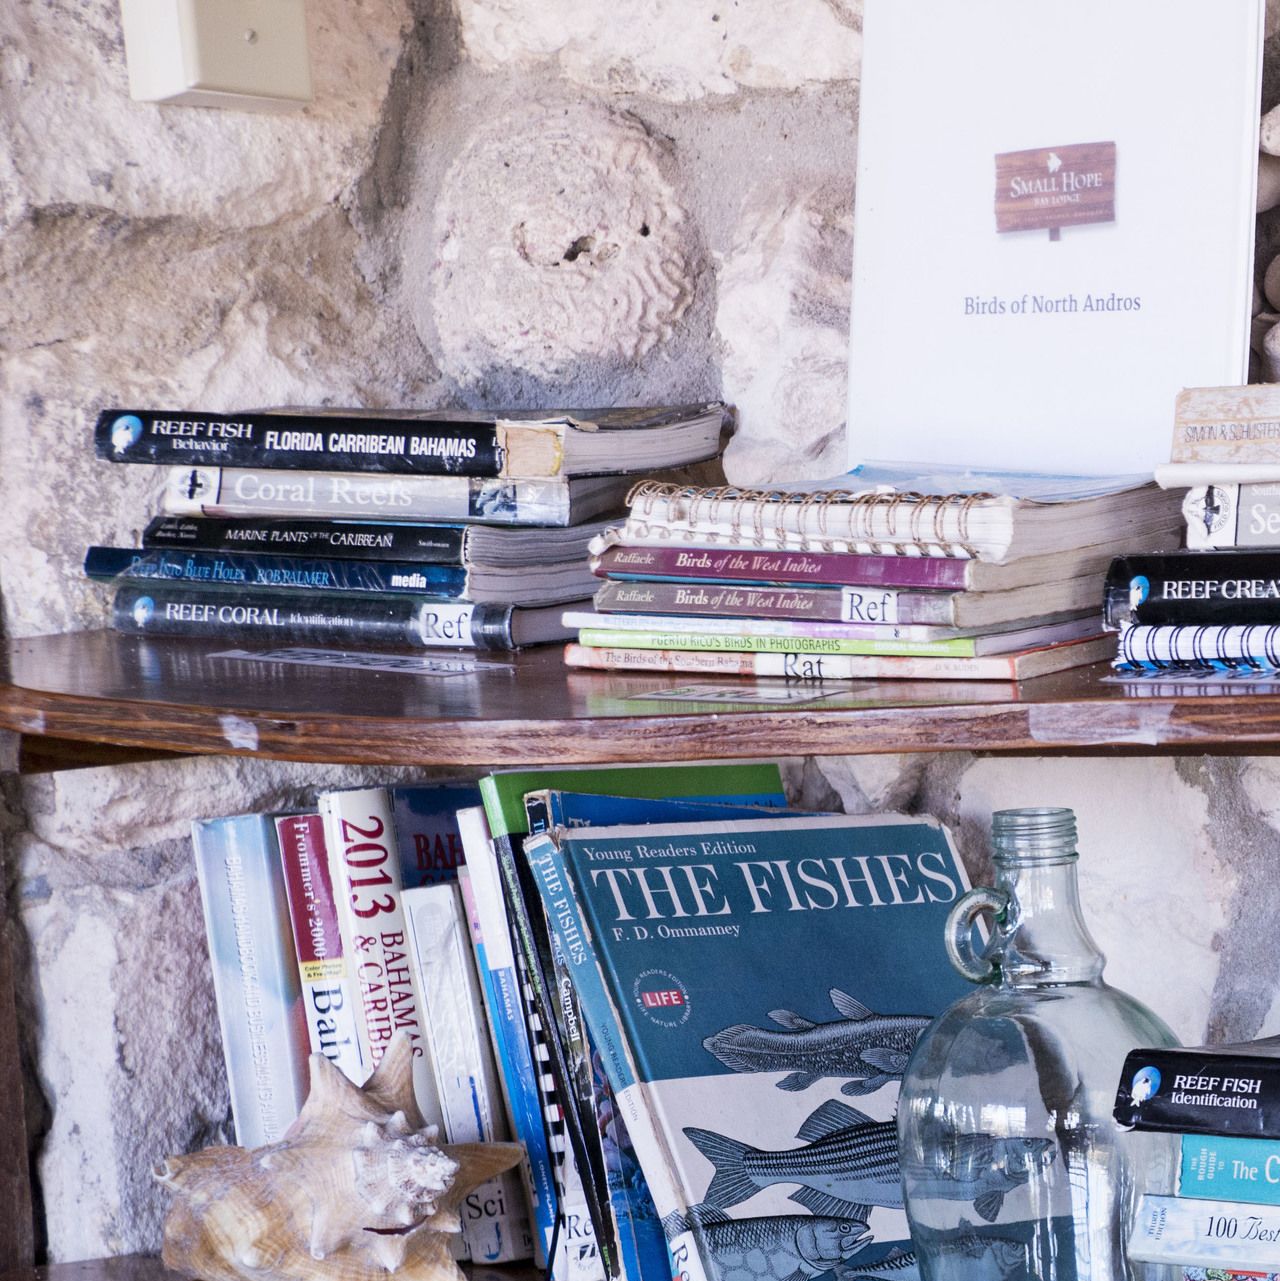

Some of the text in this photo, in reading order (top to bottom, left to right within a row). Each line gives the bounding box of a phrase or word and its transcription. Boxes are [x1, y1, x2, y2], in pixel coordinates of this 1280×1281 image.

[1010, 172, 1102, 198] SMALL HOPE
[964, 292, 1141, 316] Birds of North Andros
[152, 421, 252, 440] REEF FISH
[172, 438, 229, 451] Behavior
[265, 431, 323, 452] FLORIDA
[329, 433, 404, 454] CARRIBEAN
[410, 437, 476, 457] BAHAMAS
[235, 475, 412, 506] Coral Reefs
[226, 530, 267, 541] MARINE
[270, 531, 308, 542] PLANTS
[330, 532, 393, 547] CARIBBEAN
[614, 553, 822, 573] Raffaele Birds of the West Indies
[391, 573, 426, 588] media
[1163, 581, 1219, 599] REEF
[616, 590, 813, 610] Raffaele Birds of the West Indies
[849, 592, 892, 622] Ref
[166, 603, 216, 622] REEF
[219, 606, 284, 626] CORAL
[425, 612, 468, 639] Ref
[725, 637, 840, 650] BIRDS IN PHOTOGRAPHS
[605, 652, 658, 665] The Birds of
[784, 653, 824, 679] Rat
[583, 841, 756, 862] Young Readers Edition
[342, 816, 396, 919] 2013
[294, 822, 320, 911] Frommer's
[308, 918, 326, 957] 2000
[590, 852, 955, 920] THE FISHES
[538, 853, 556, 896] THE
[554, 901, 588, 966] FISHES
[356, 935, 377, 953] &
[612, 925, 740, 941] F. D. Ommanney
[499, 970, 514, 1020] BAHAMAS
[645, 991, 680, 1006] LIFE
[561, 978, 580, 1042] Campbell
[1174, 1075, 1261, 1094] REEF FISH
[1171, 1092, 1257, 1109] Identification
[1198, 1148, 1208, 1180] ROUGH
[1207, 1151, 1217, 1179] GUIDE
[1218, 1161, 1224, 1170] TO
[1232, 1160, 1258, 1181] The
[465, 1190, 506, 1220] Sci
[1205, 1216, 1238, 1239] 100
